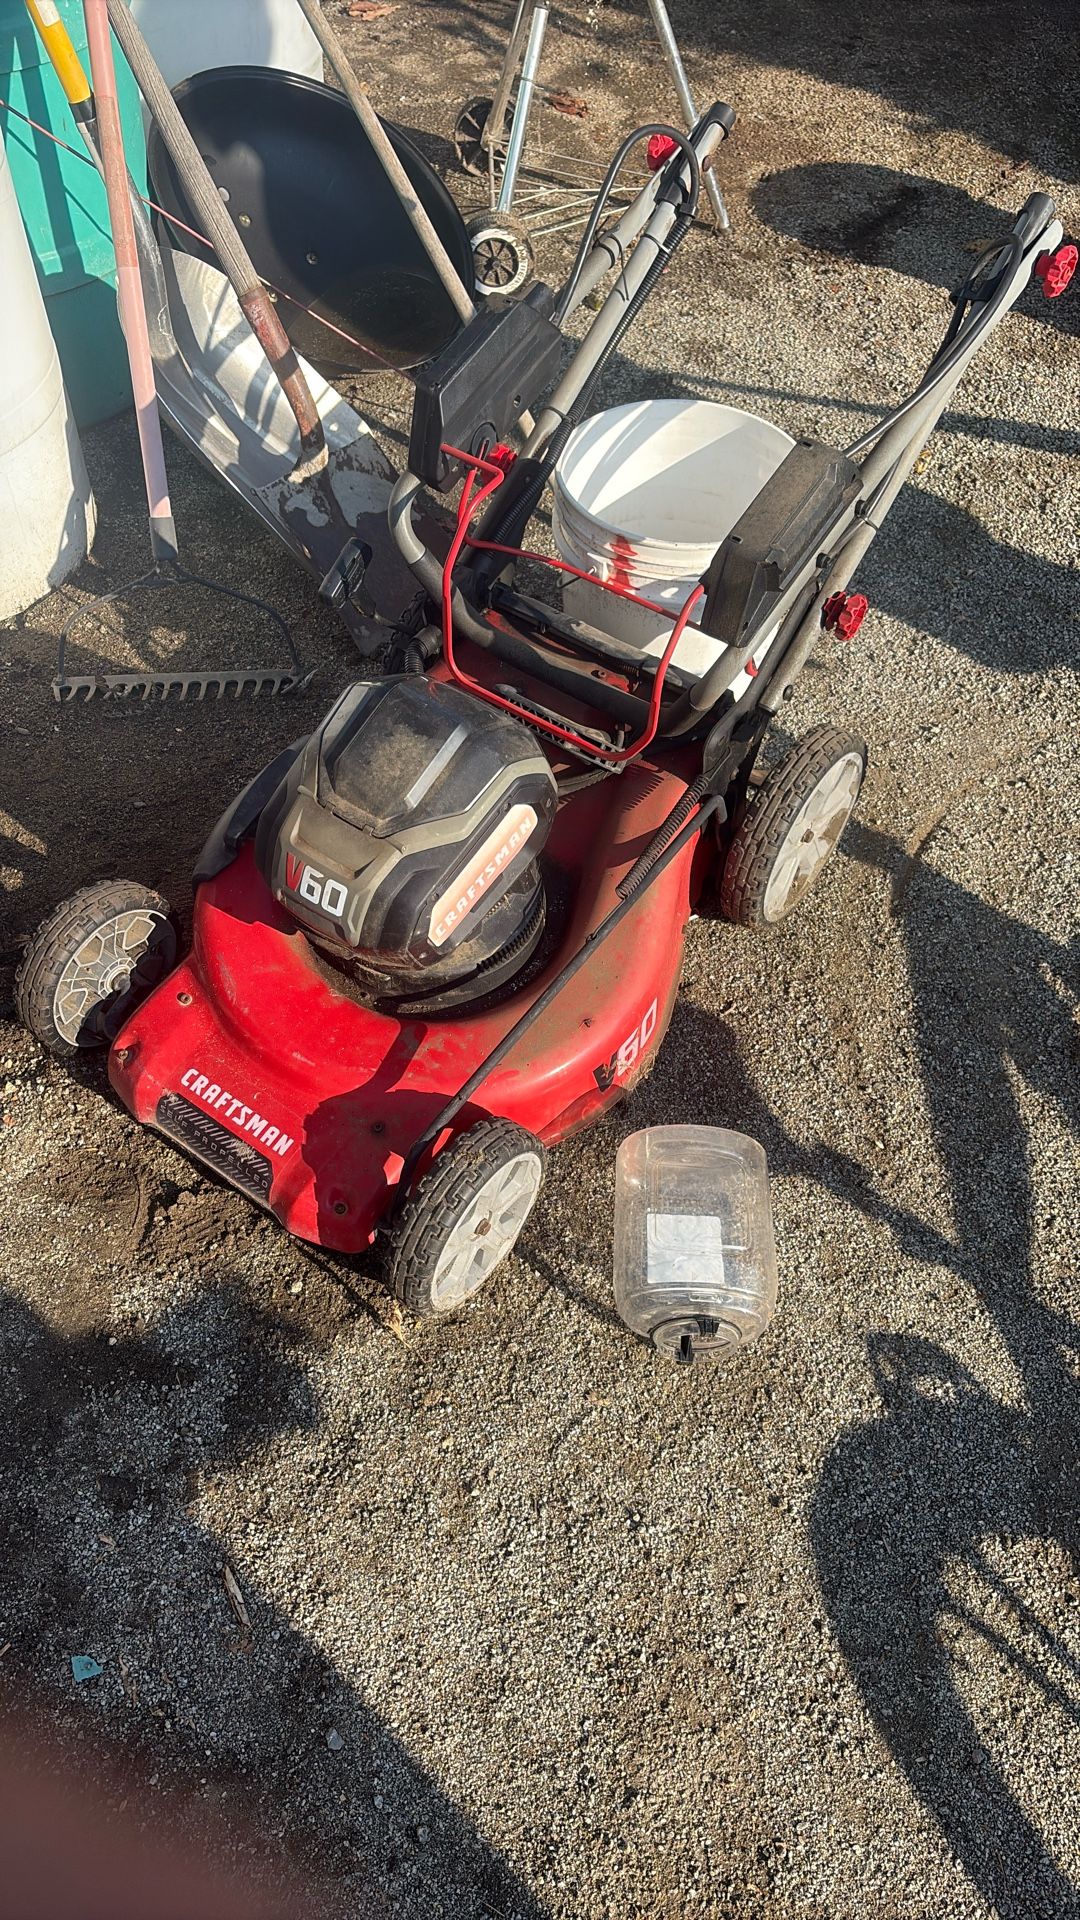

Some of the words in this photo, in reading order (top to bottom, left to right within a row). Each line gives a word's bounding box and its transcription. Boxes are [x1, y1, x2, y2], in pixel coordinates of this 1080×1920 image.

[286, 852, 348, 917] V60
[435, 816, 532, 938] CRAFTSMAN
[160, 1104, 188, 1128] SELF
[194, 1130, 268, 1188] PROPELLED
[180, 1068, 294, 1157] CRAFTSMAN
